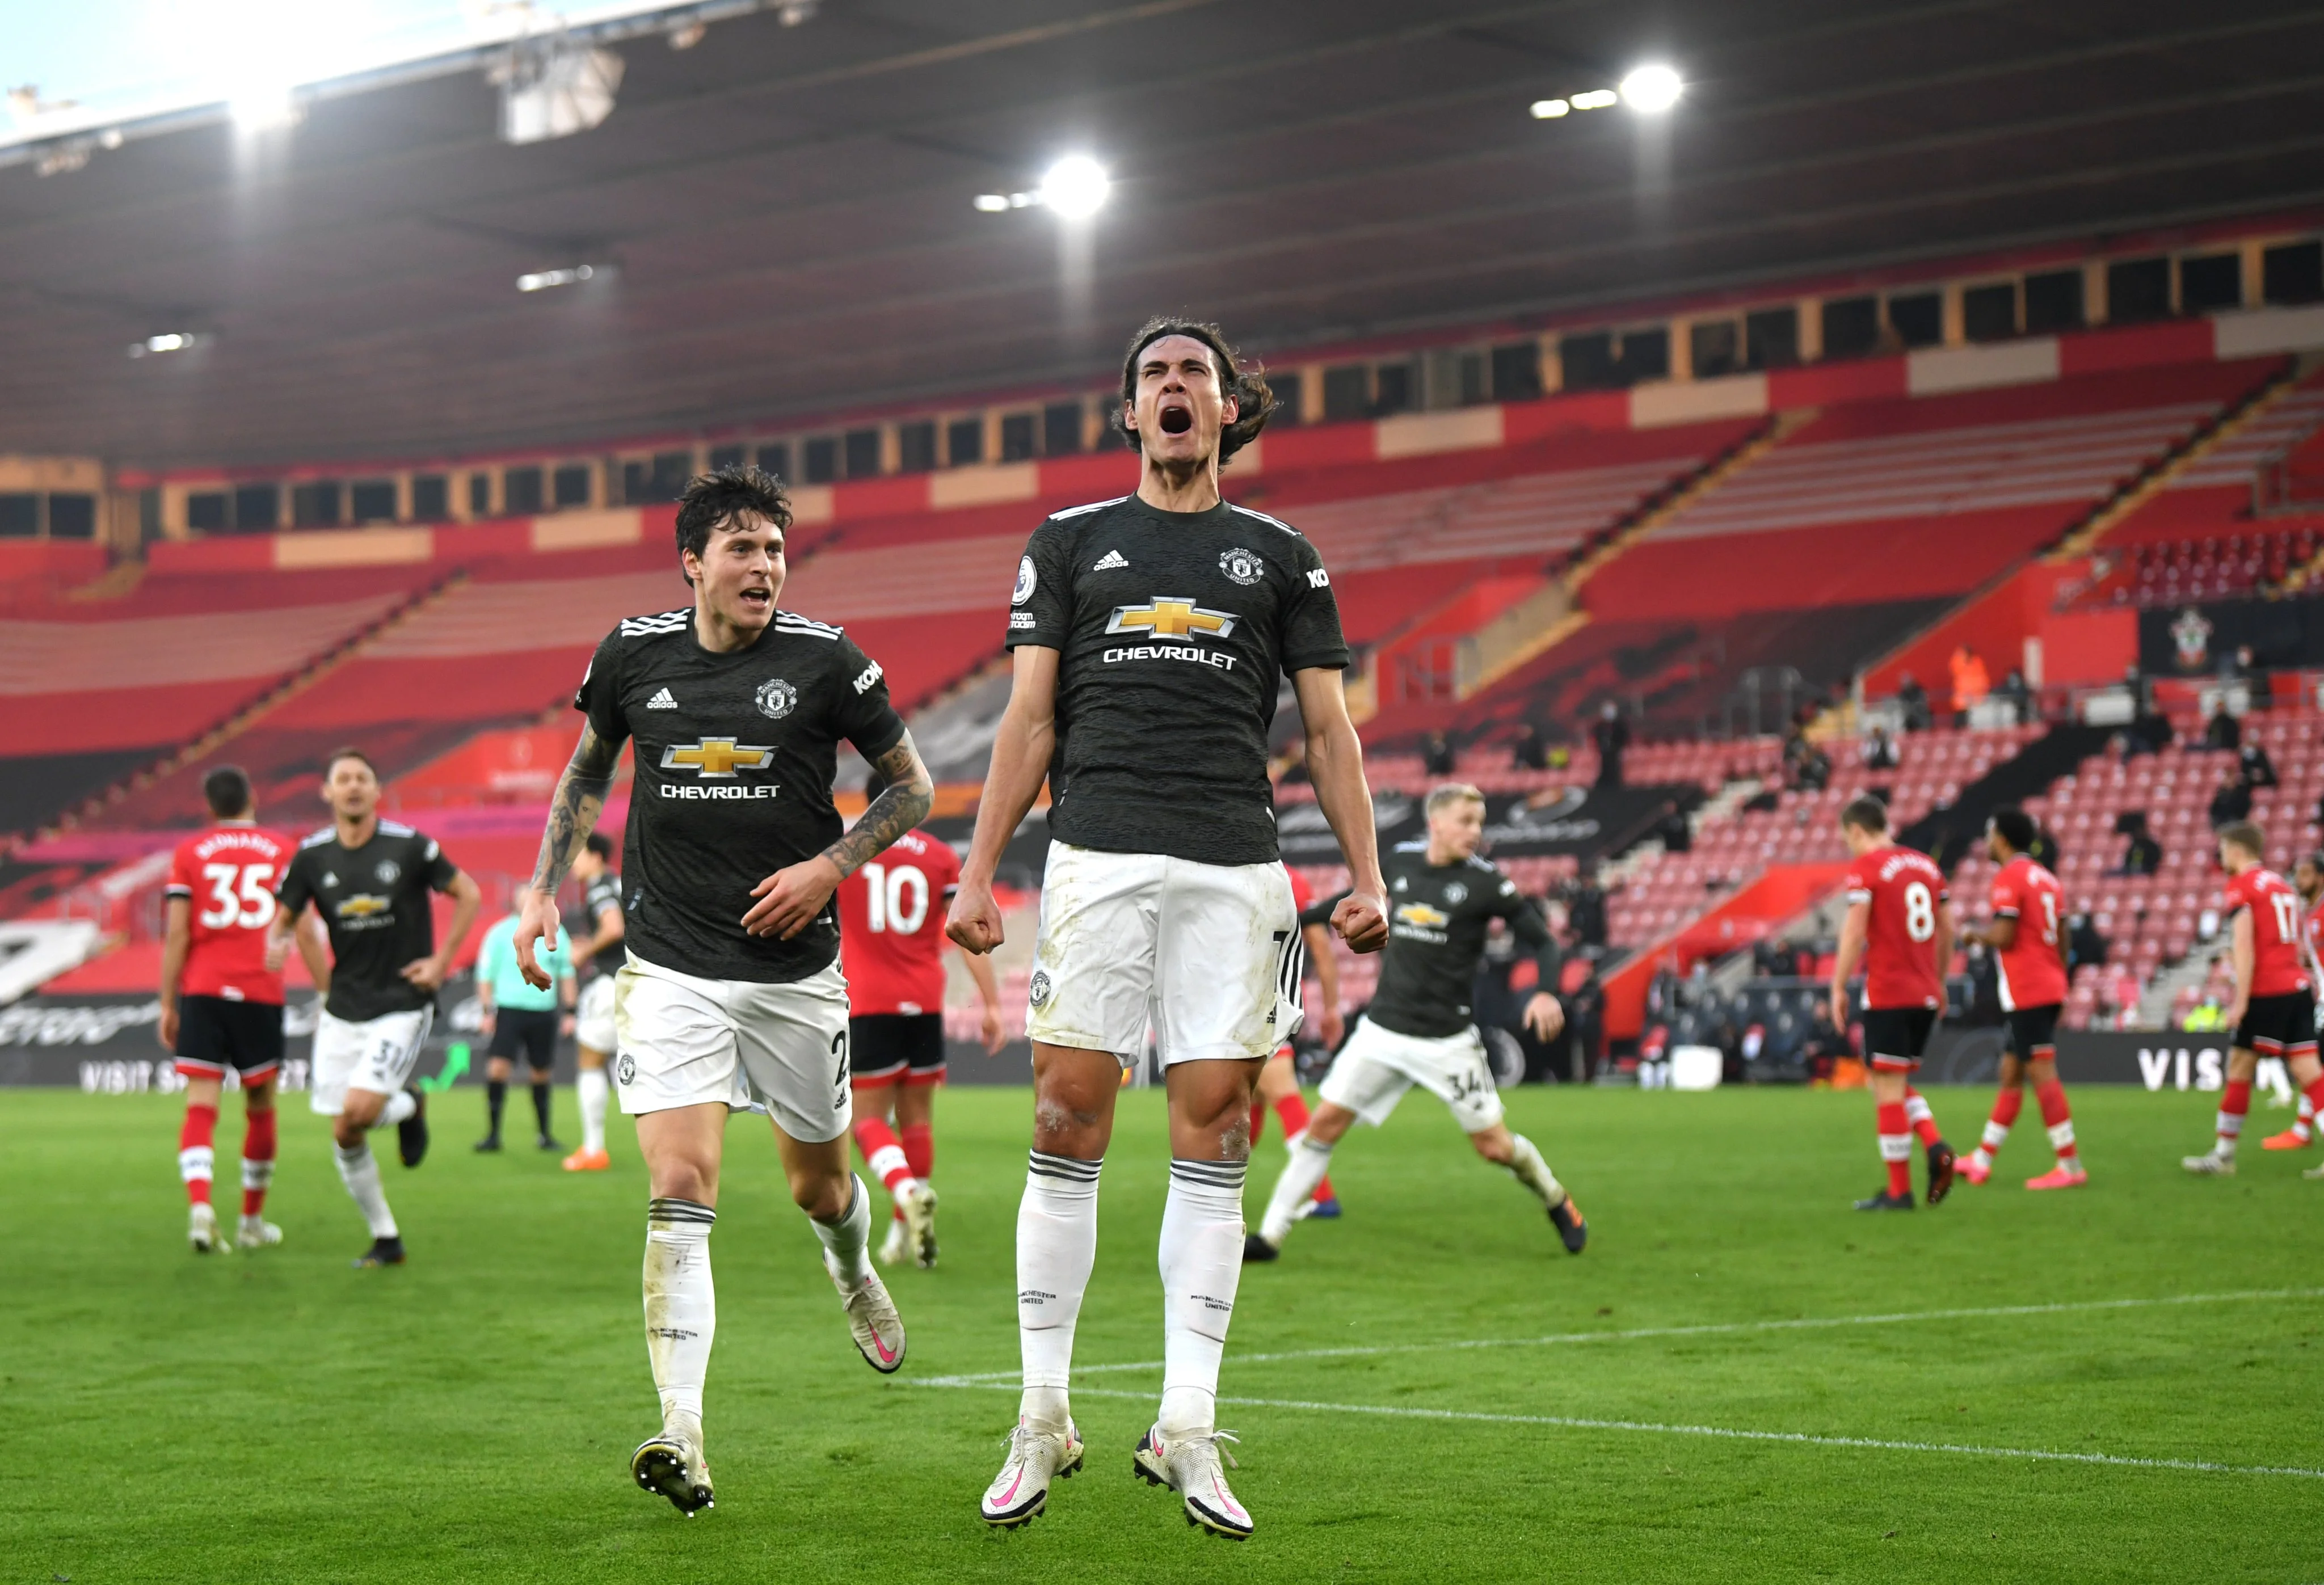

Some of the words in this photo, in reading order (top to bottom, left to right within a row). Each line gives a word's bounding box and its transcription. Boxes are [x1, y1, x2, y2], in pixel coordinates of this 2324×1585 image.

[1093, 560, 1129, 571] adidas
[1224, 550, 1260, 567] MANCHESTER
[1230, 572, 1255, 583] UNITED
[1104, 646, 1237, 671] CHEVROLET
[761, 681, 794, 695] MANCHESTER
[660, 784, 781, 799] CHEVROLET
[201, 863, 277, 930] 35
[861, 861, 930, 935] 10
[1905, 882, 1935, 943] 8
[2271, 891, 2298, 944] 17
[831, 1030, 847, 1086] 2
[79, 1060, 154, 1095] VISIT
[1446, 1069, 1481, 1102] 34
[1205, 1302, 1230, 1311] UNITED
